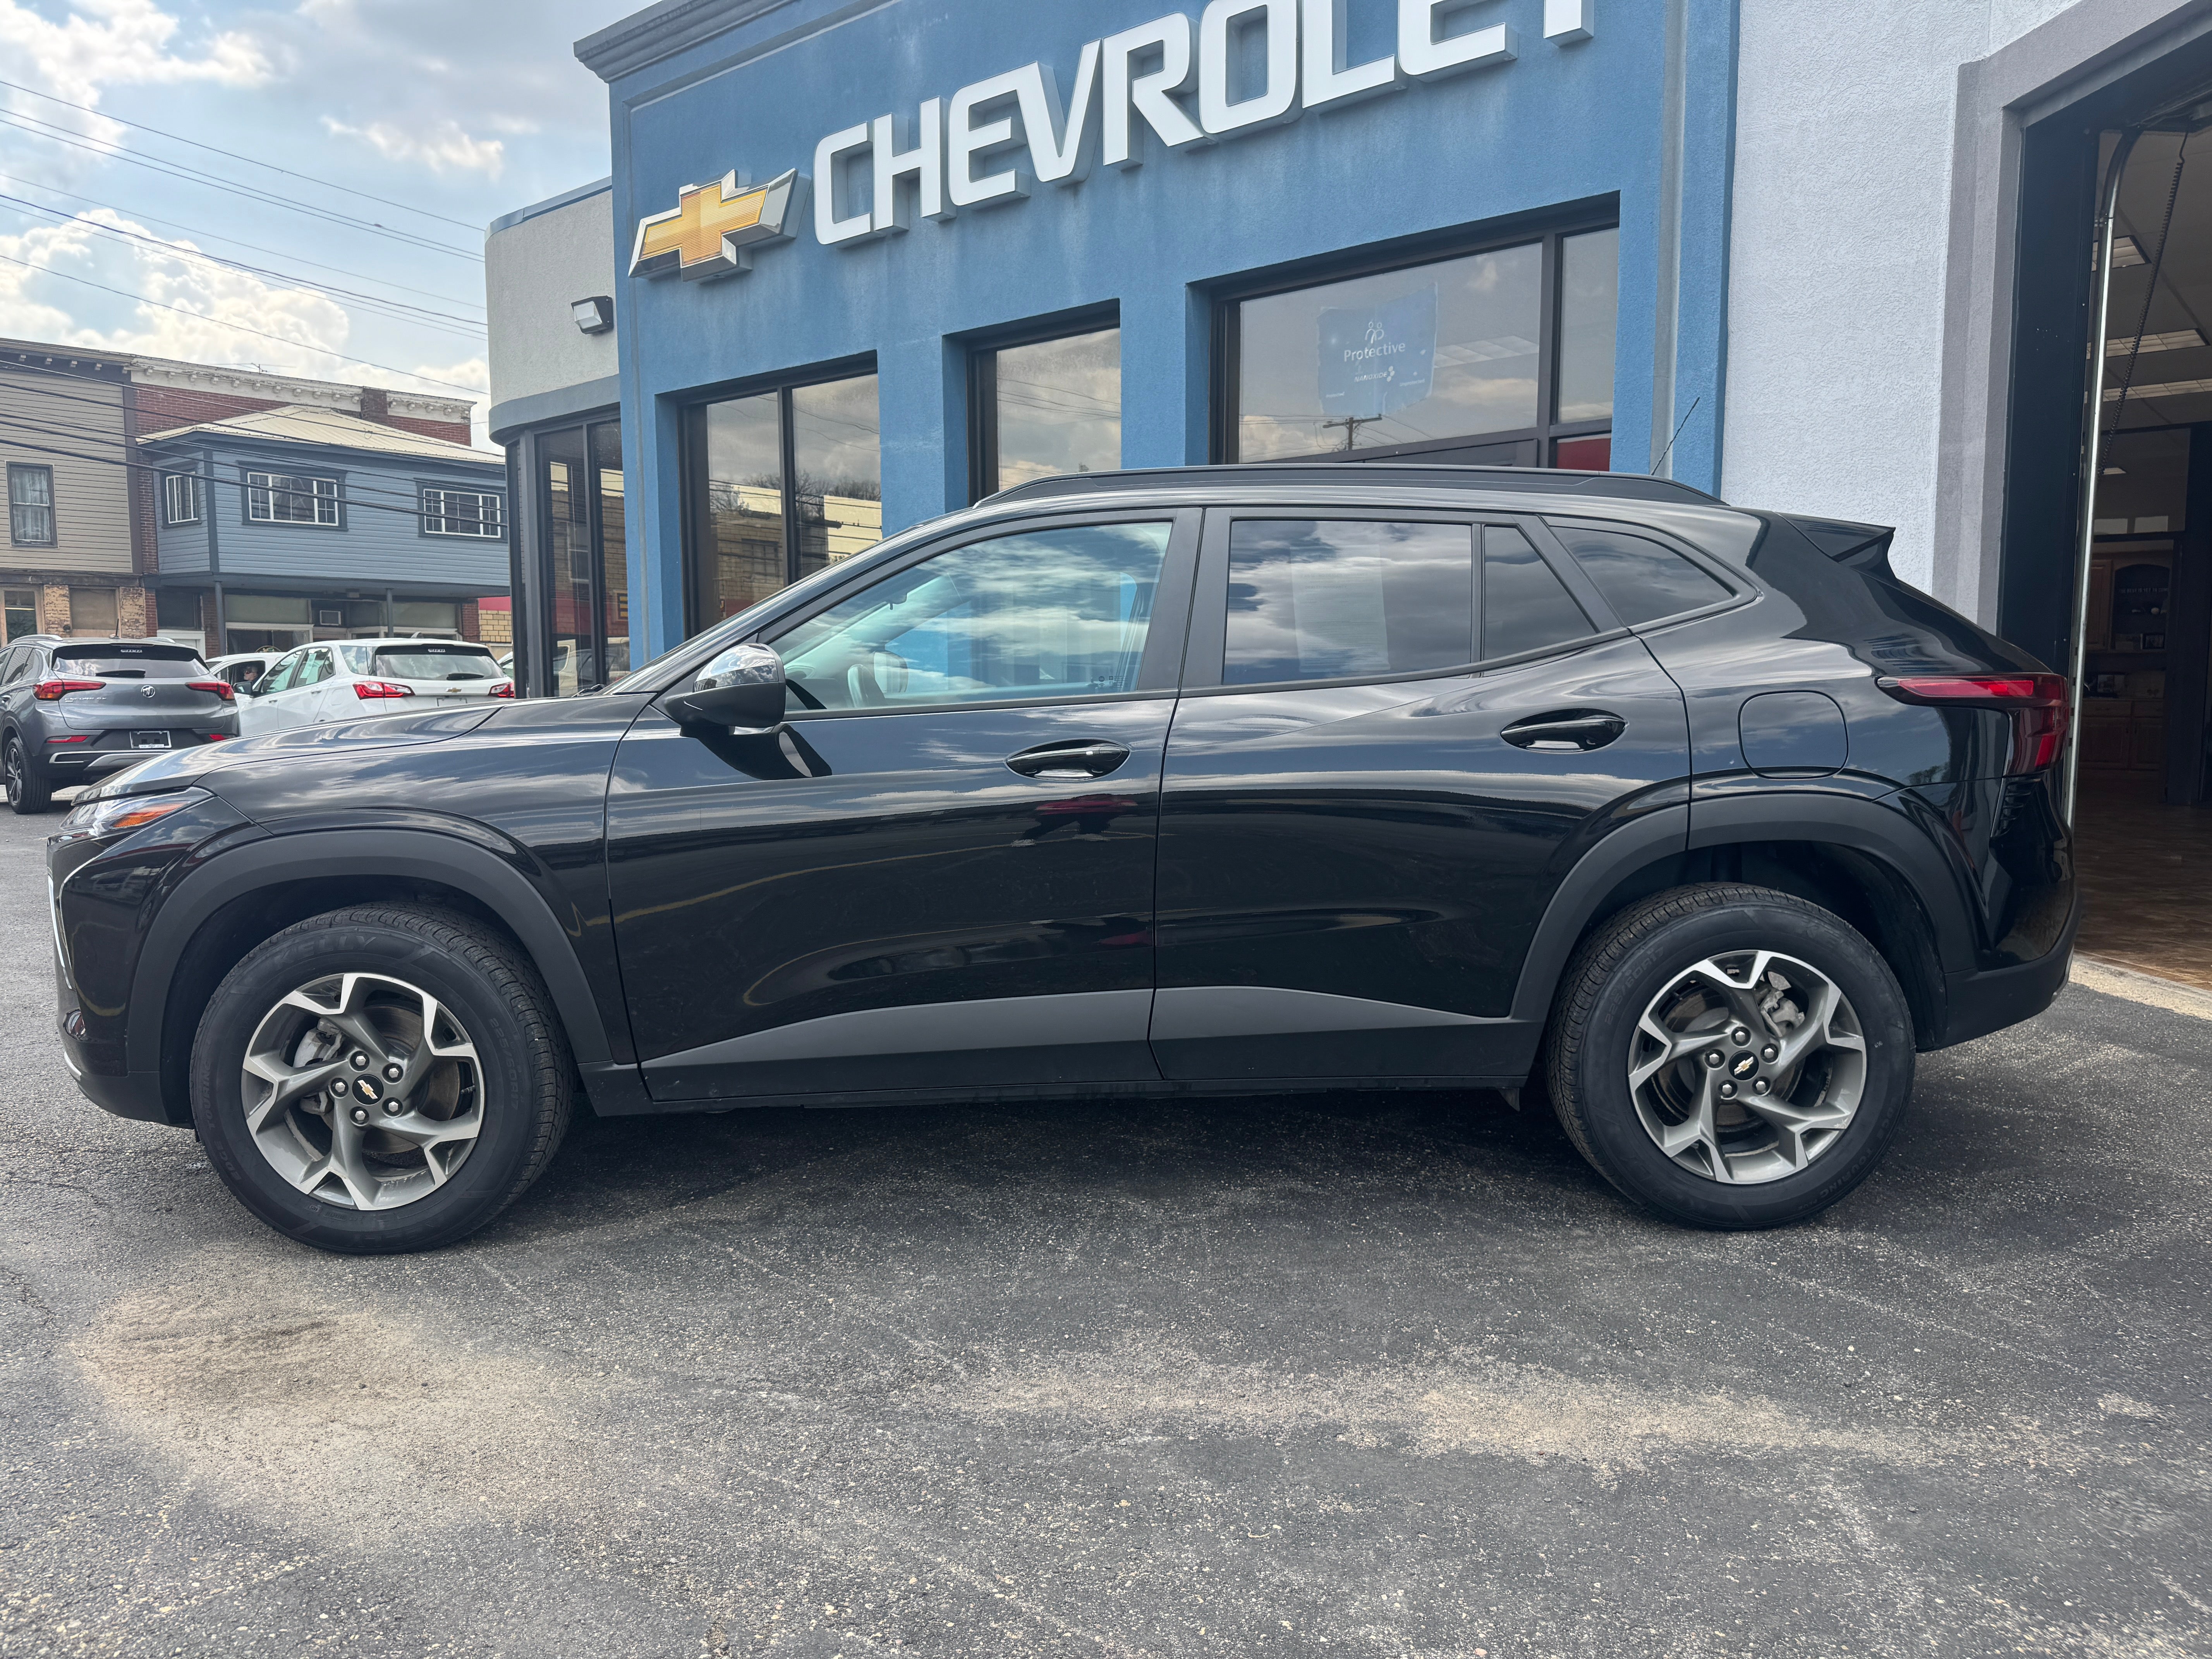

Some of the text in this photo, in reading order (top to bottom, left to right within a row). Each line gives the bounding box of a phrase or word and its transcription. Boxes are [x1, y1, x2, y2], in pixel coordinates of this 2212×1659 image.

[814, 0, 1583, 246] CHEVROL
[1344, 342, 1406, 362] Protective
[1354, 371, 1388, 383] NANOXIDE
[273, 935, 378, 969] KELLY
[488, 1017, 519, 1110] 225/60R17
[201, 1058, 215, 1130] TOURING
[214, 1140, 242, 1181] EDGE
